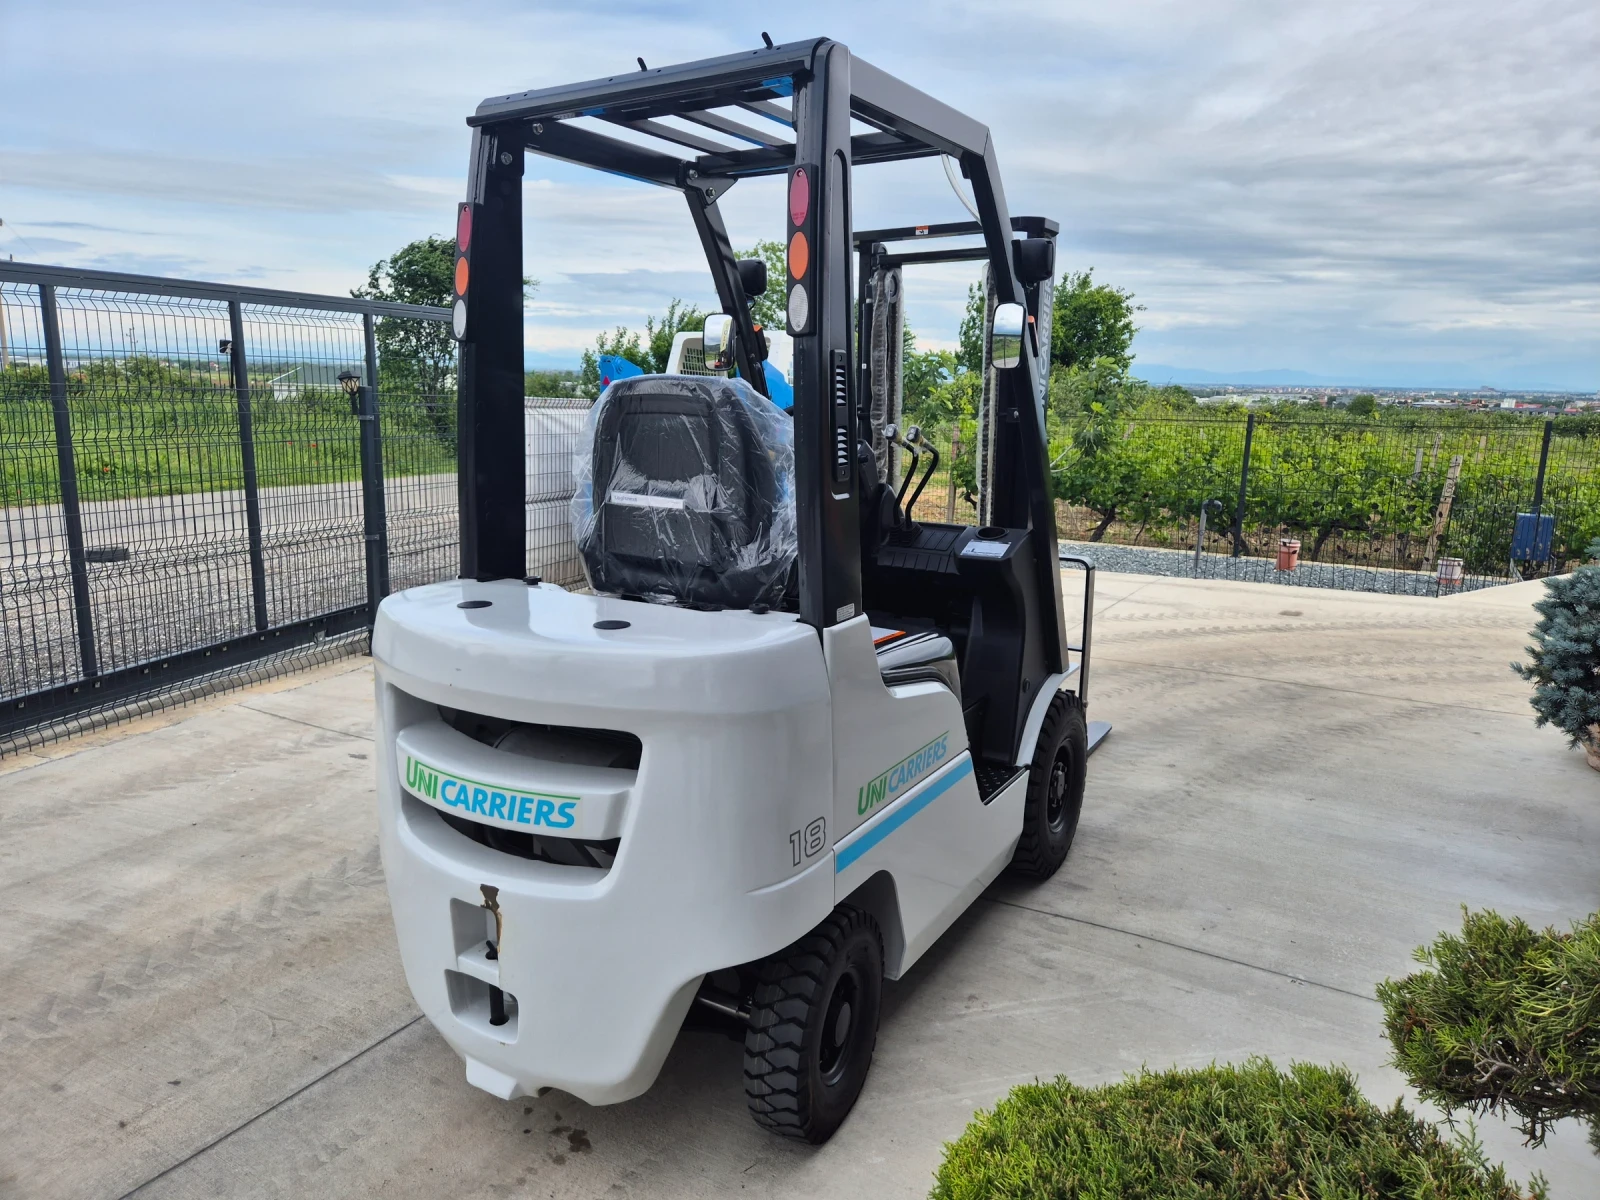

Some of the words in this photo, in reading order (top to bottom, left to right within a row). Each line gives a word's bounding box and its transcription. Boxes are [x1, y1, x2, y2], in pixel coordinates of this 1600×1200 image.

[406, 755, 577, 829] UNICARRIERS
[857, 735, 948, 816] UNICARRIERS
[789, 816, 826, 867] 18
